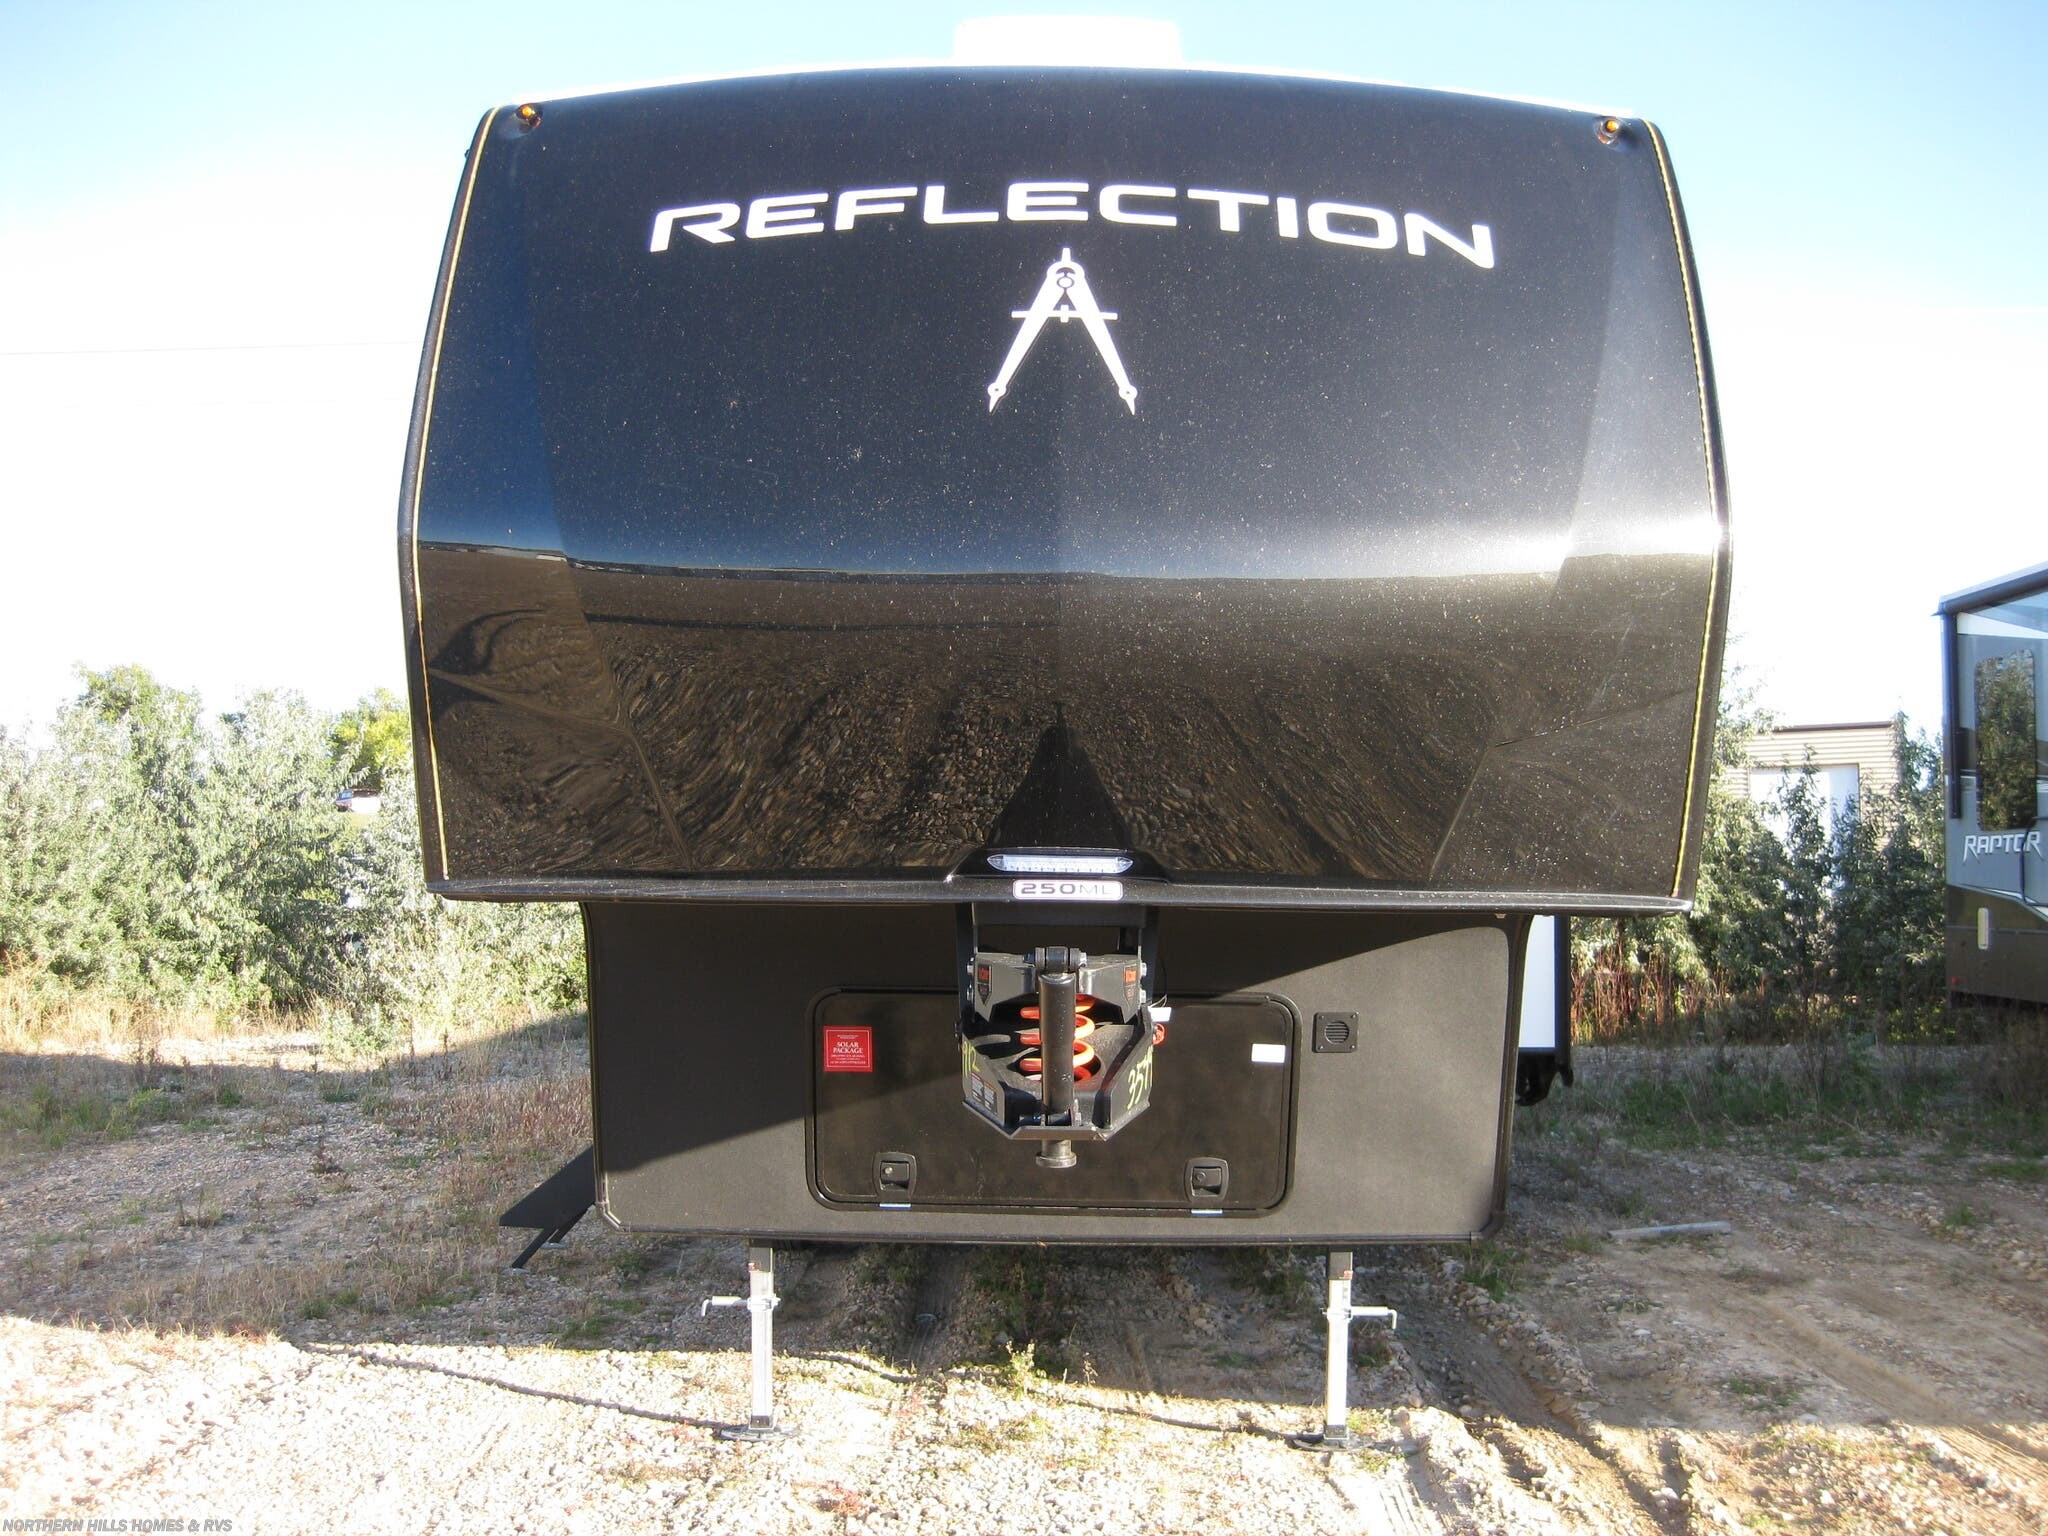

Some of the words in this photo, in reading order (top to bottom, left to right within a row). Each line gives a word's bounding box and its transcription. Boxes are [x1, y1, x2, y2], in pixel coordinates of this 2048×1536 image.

[649, 181, 1496, 270] REFLECTION
[1962, 831, 2044, 862] RAPTOR
[1020, 883, 1113, 895] 250ML
